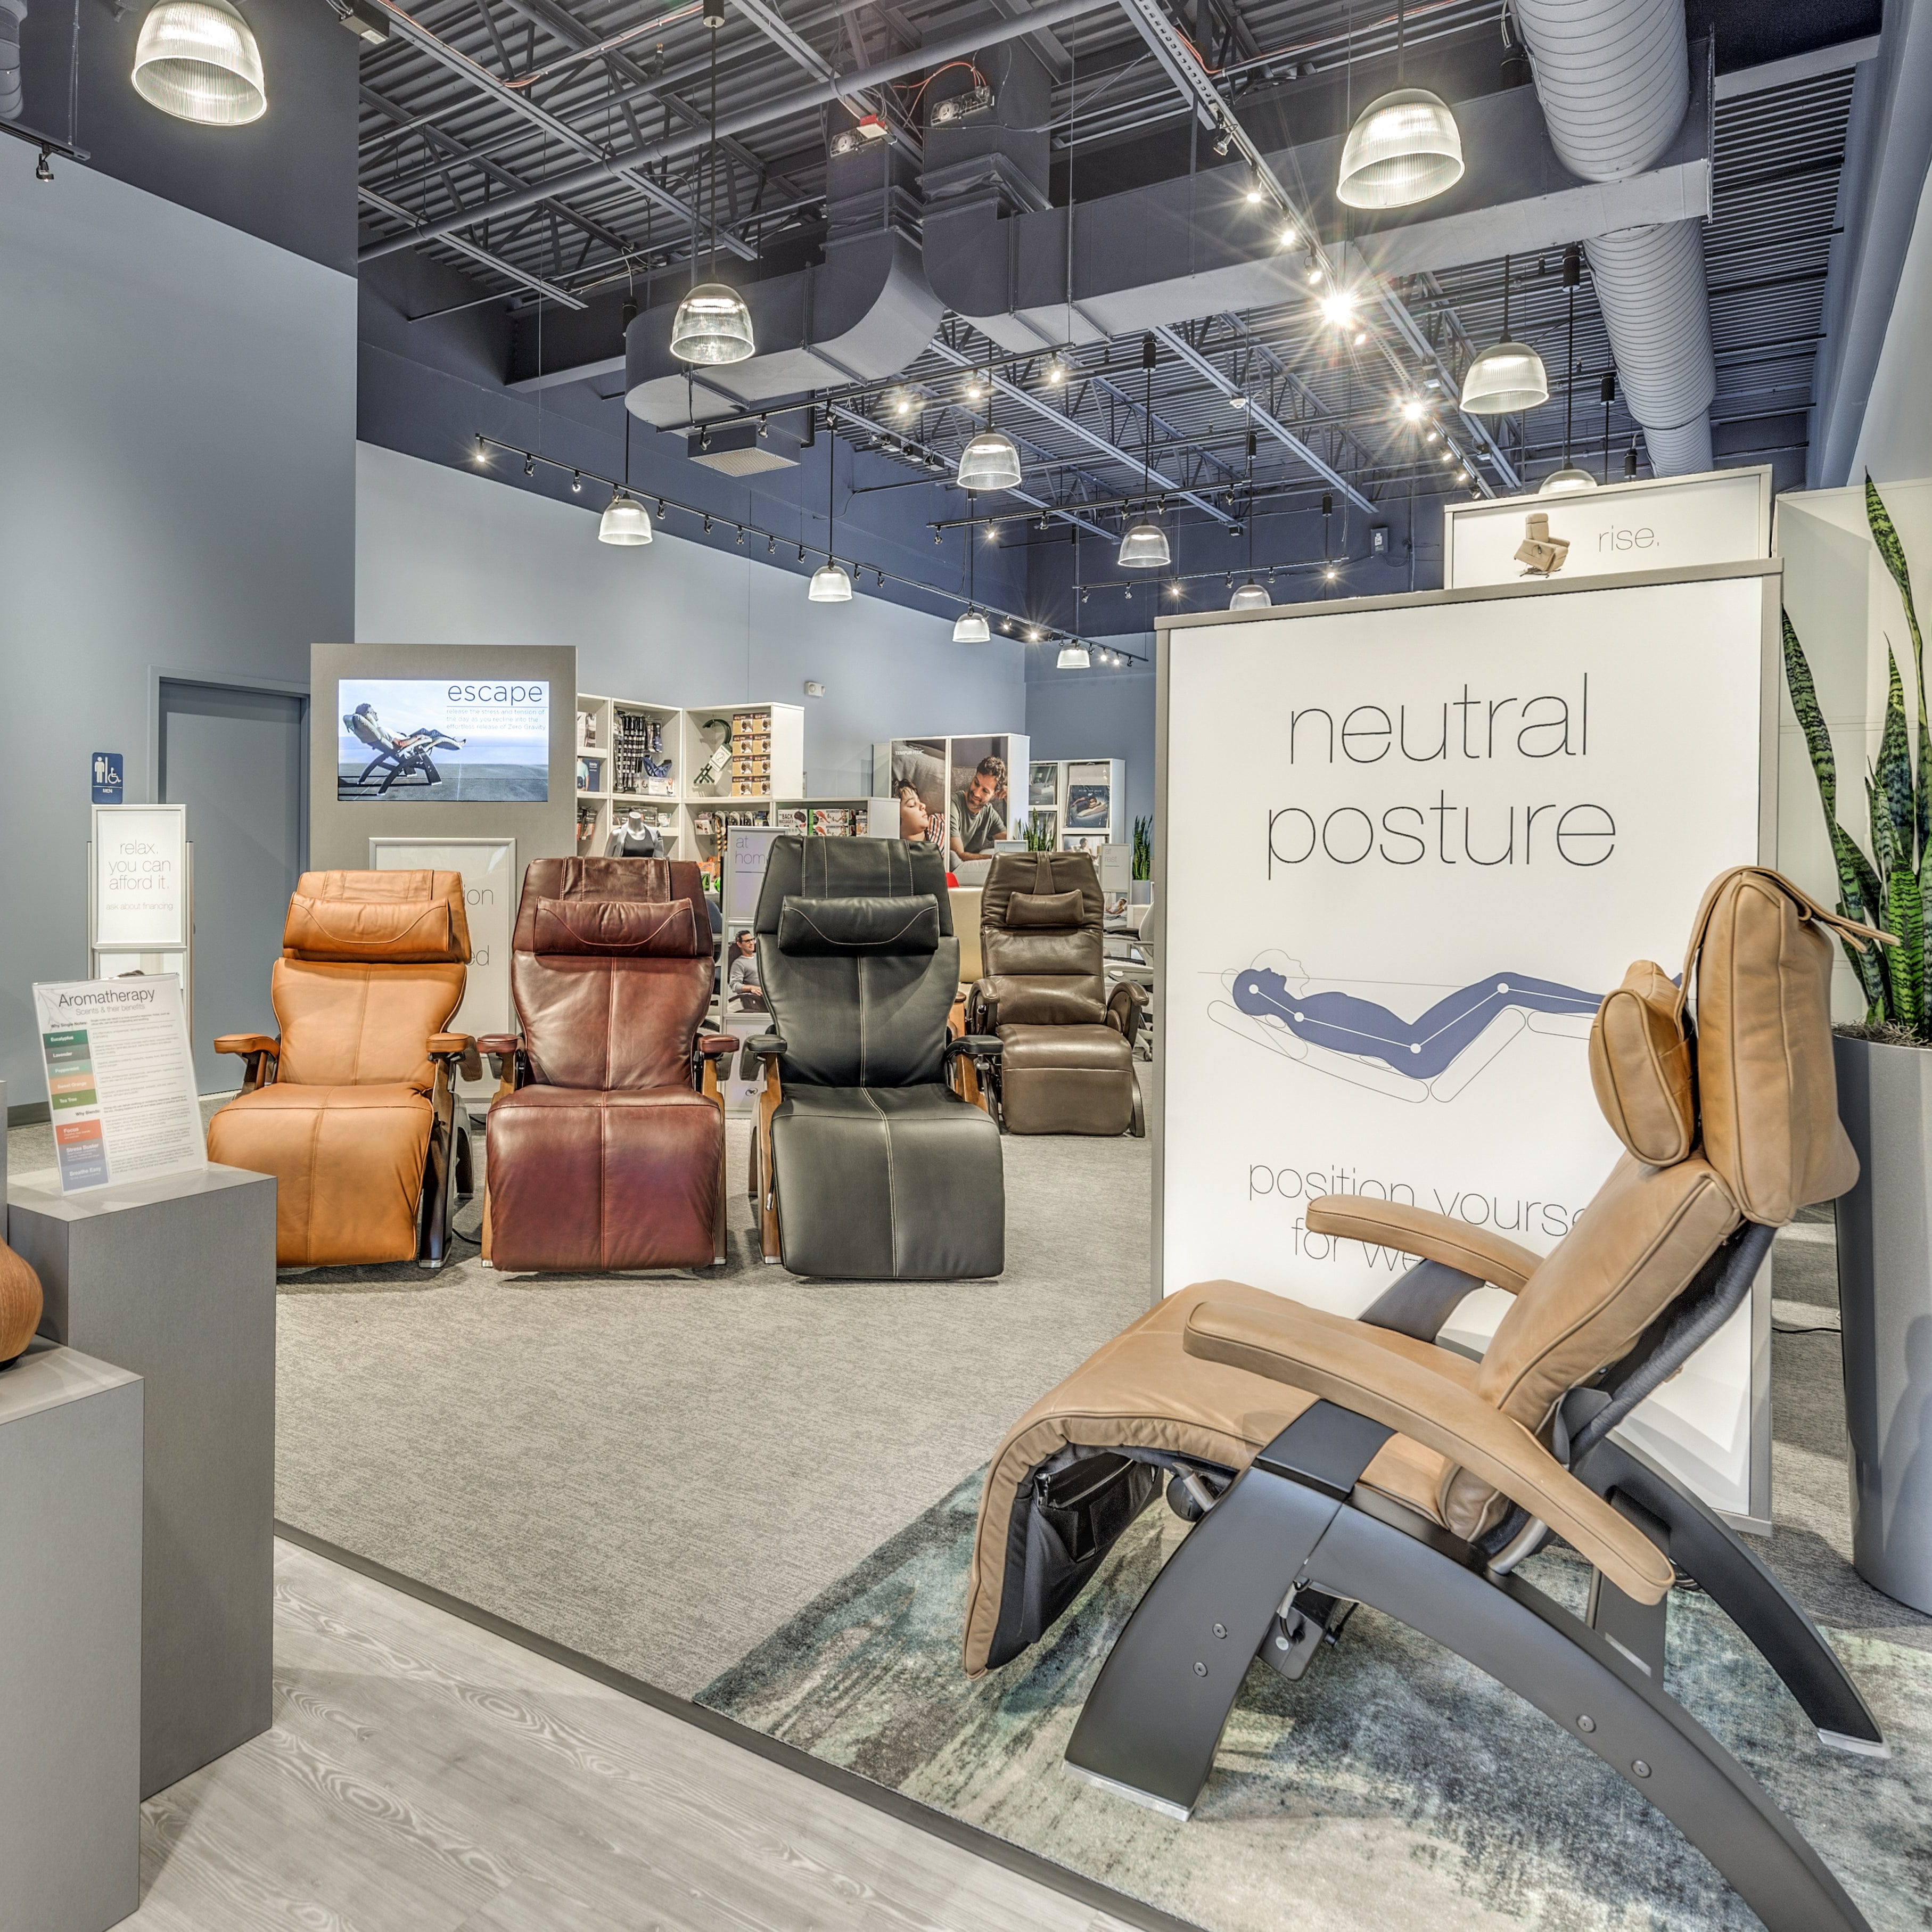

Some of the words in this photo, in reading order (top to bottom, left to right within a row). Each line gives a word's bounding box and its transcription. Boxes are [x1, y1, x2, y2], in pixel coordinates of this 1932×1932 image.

[1599, 525, 1659, 552] rise.
[448, 685, 542, 706] escape
[1290, 672, 1588, 764] neutral
[736, 836, 749, 849] at
[1268, 789, 1616, 881] posture
[120, 840, 159, 855] relax.
[735, 851, 768, 864] hom
[108, 860, 136, 876] you
[142, 860, 171, 872] can
[109, 875, 152, 890] afford
[158, 875, 169, 890] it.
[143, 902, 174, 911] financing
[59, 990, 155, 1007] Aromatherapy
[76, 1007, 99, 1016] Scents
[121, 1002, 145, 1011] benefits
[69, 1168, 89, 1177] Breathe
